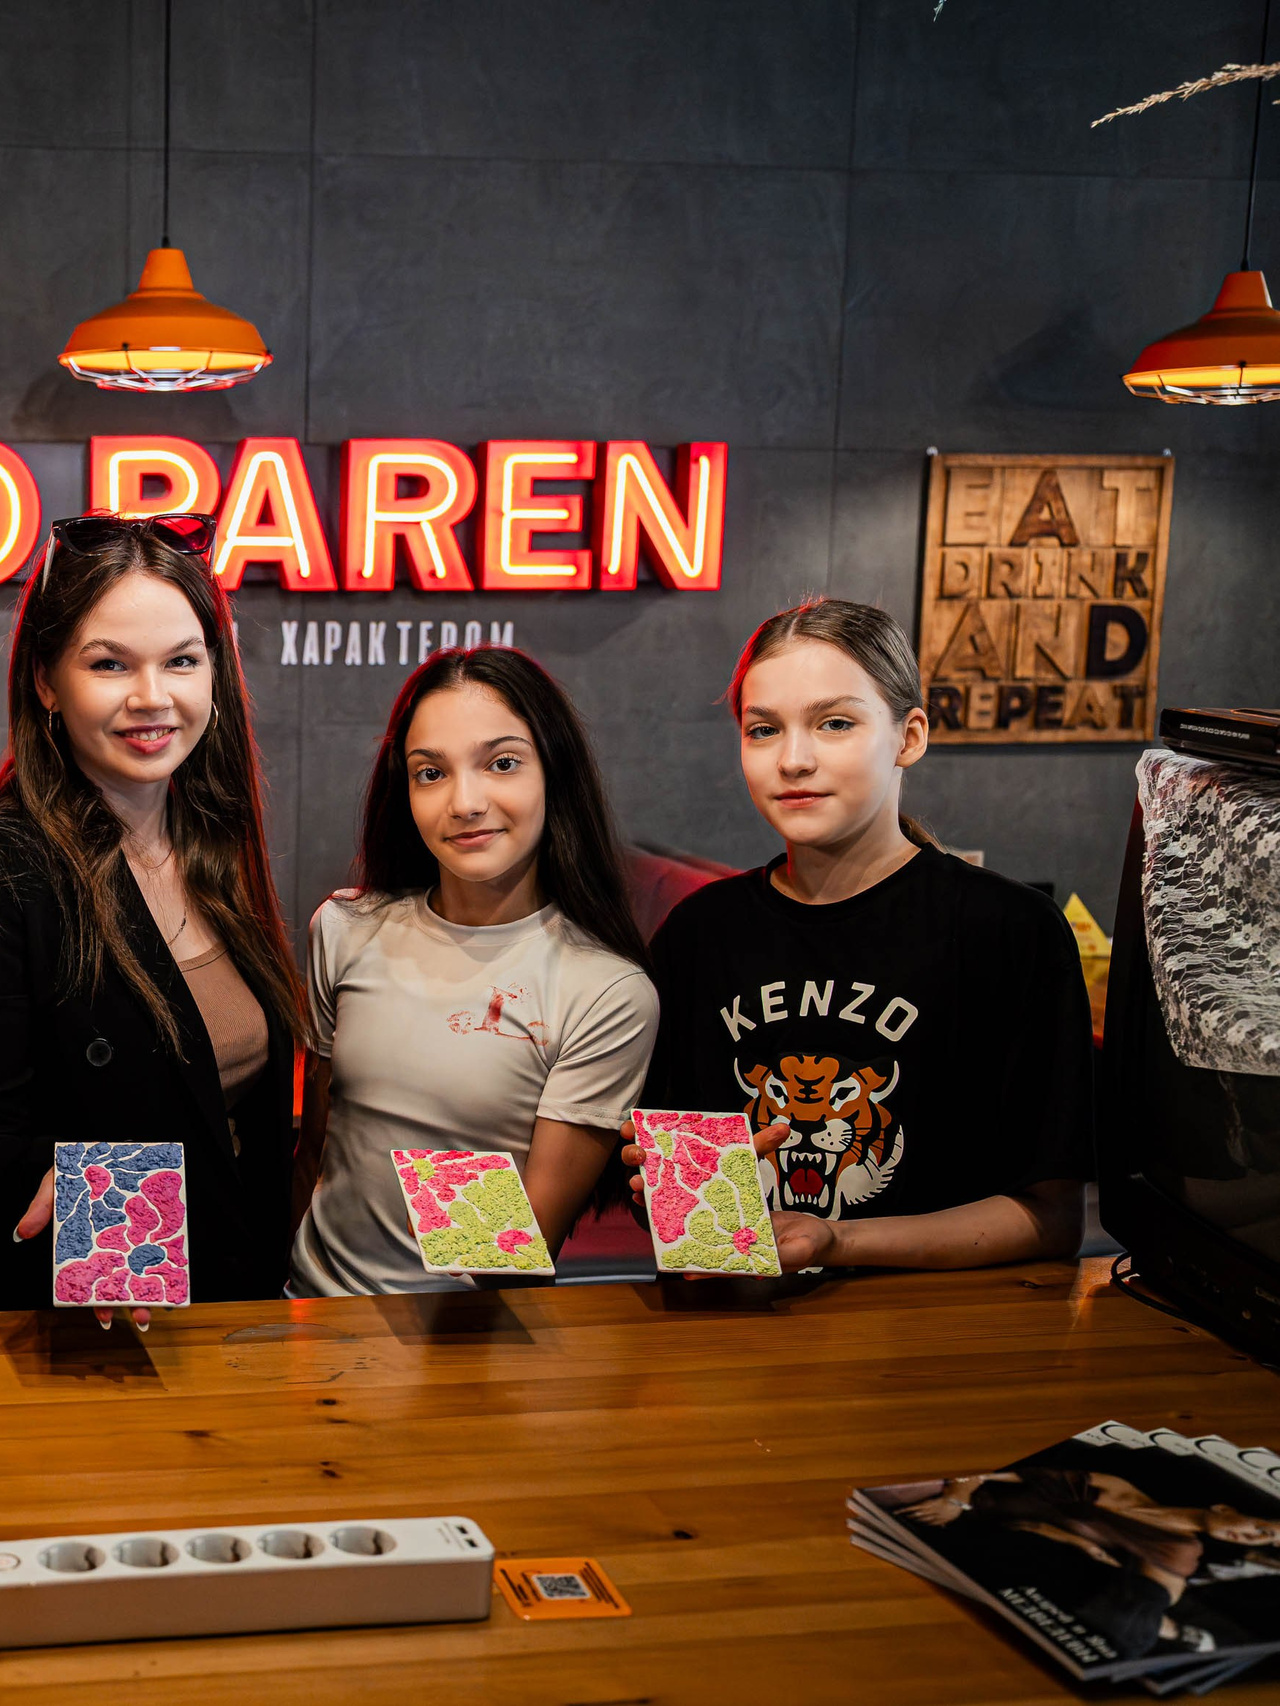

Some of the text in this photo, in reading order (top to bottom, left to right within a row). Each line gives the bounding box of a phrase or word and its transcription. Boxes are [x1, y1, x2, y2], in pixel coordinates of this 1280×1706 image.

[944, 466, 1156, 548] EAT
[939, 551, 1150, 600] DRINK
[931, 601, 1149, 681] AND
[927, 684, 1147, 731] REPEAT
[720, 979, 919, 1042] KENZO
